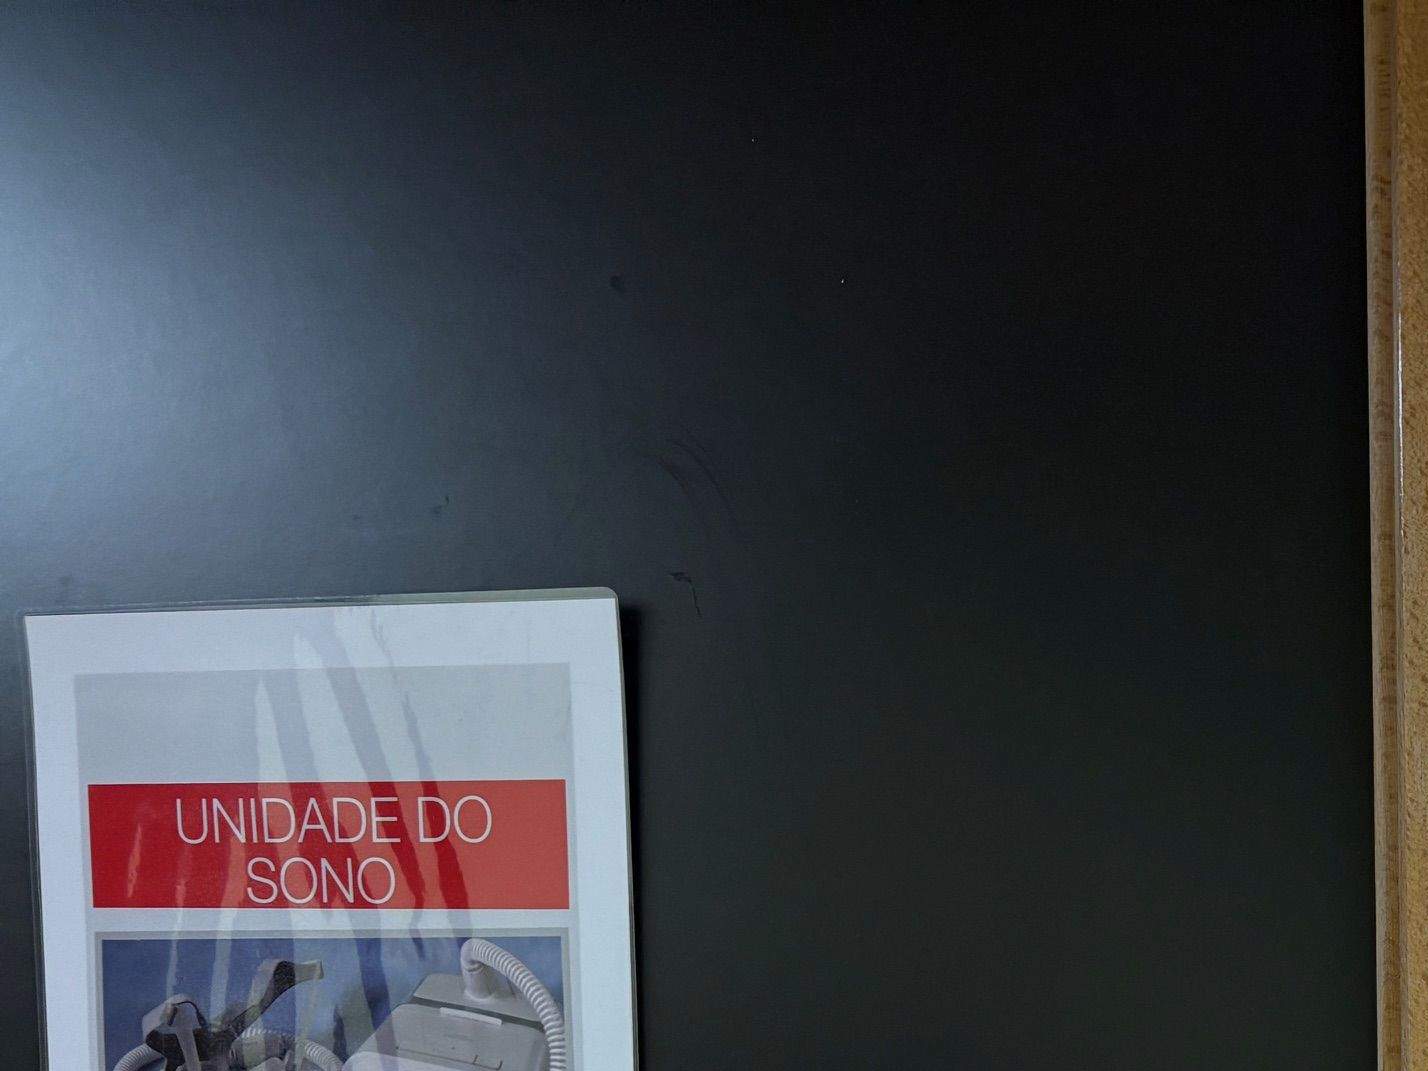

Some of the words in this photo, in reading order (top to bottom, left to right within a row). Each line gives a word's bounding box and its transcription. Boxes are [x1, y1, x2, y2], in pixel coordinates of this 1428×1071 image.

[176, 797, 401, 845] UNIDADE
[418, 795, 493, 843] DO
[247, 857, 396, 904] SONO
